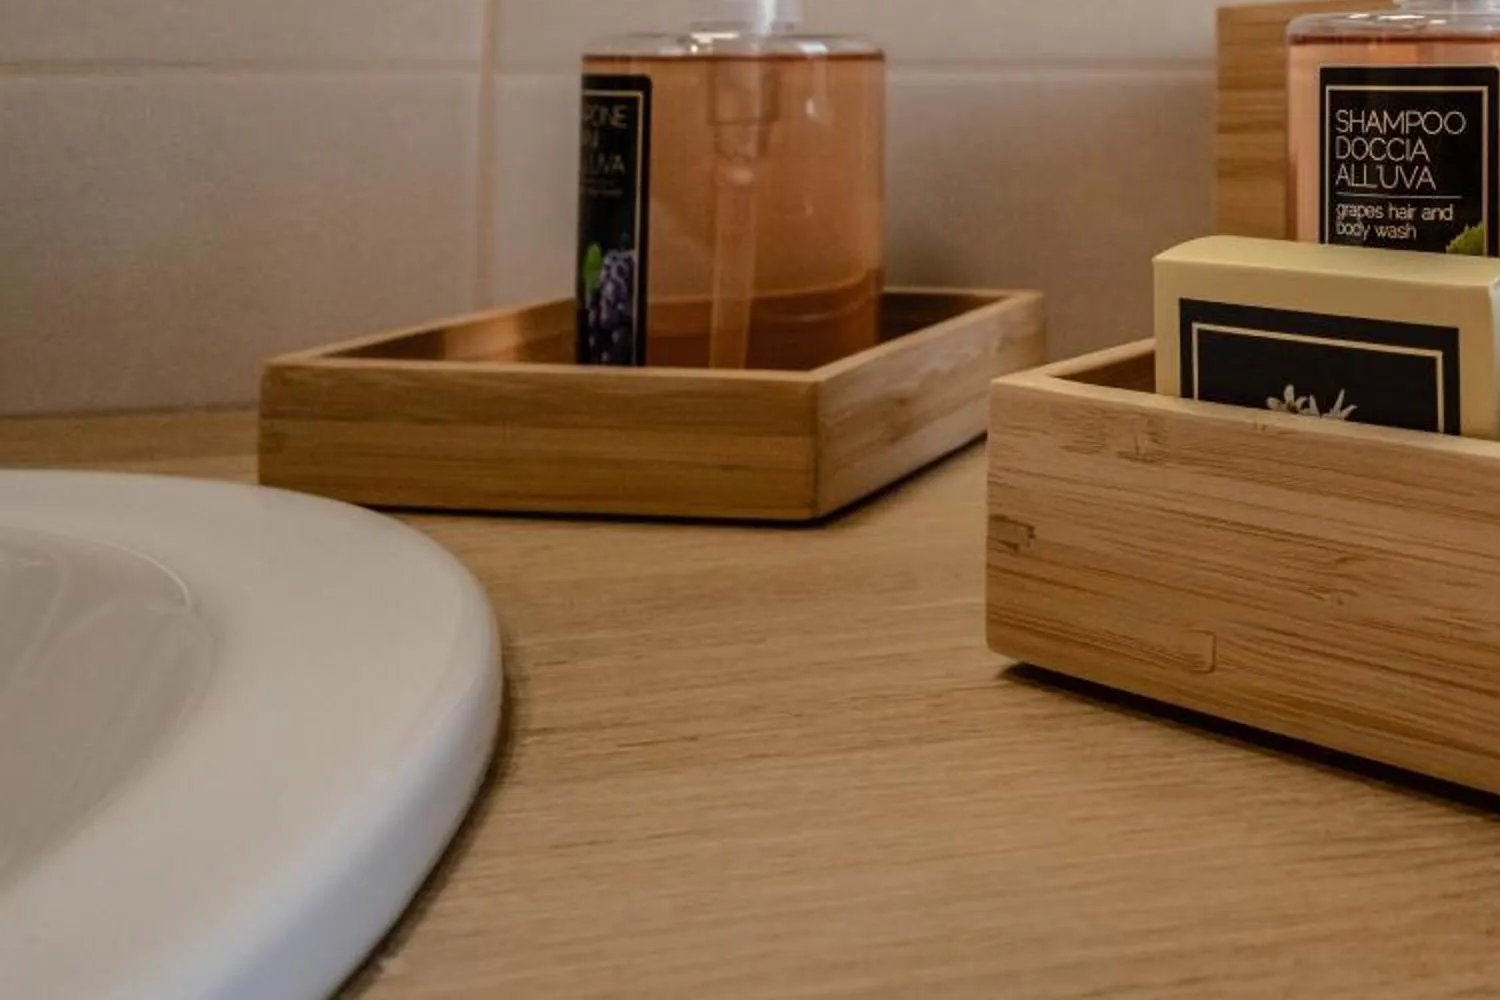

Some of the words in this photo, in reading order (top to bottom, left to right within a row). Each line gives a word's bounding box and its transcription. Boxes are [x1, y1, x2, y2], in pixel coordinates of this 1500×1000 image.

[1335, 109, 1467, 136] SHAMPOO
[1335, 136, 1431, 163] DOCCIA
[1335, 203, 1384, 223] grapes
[1387, 202, 1416, 221] hair
[1422, 203, 1454, 222] and
[1335, 221, 1371, 241] body
[1374, 222, 1417, 240] wash
